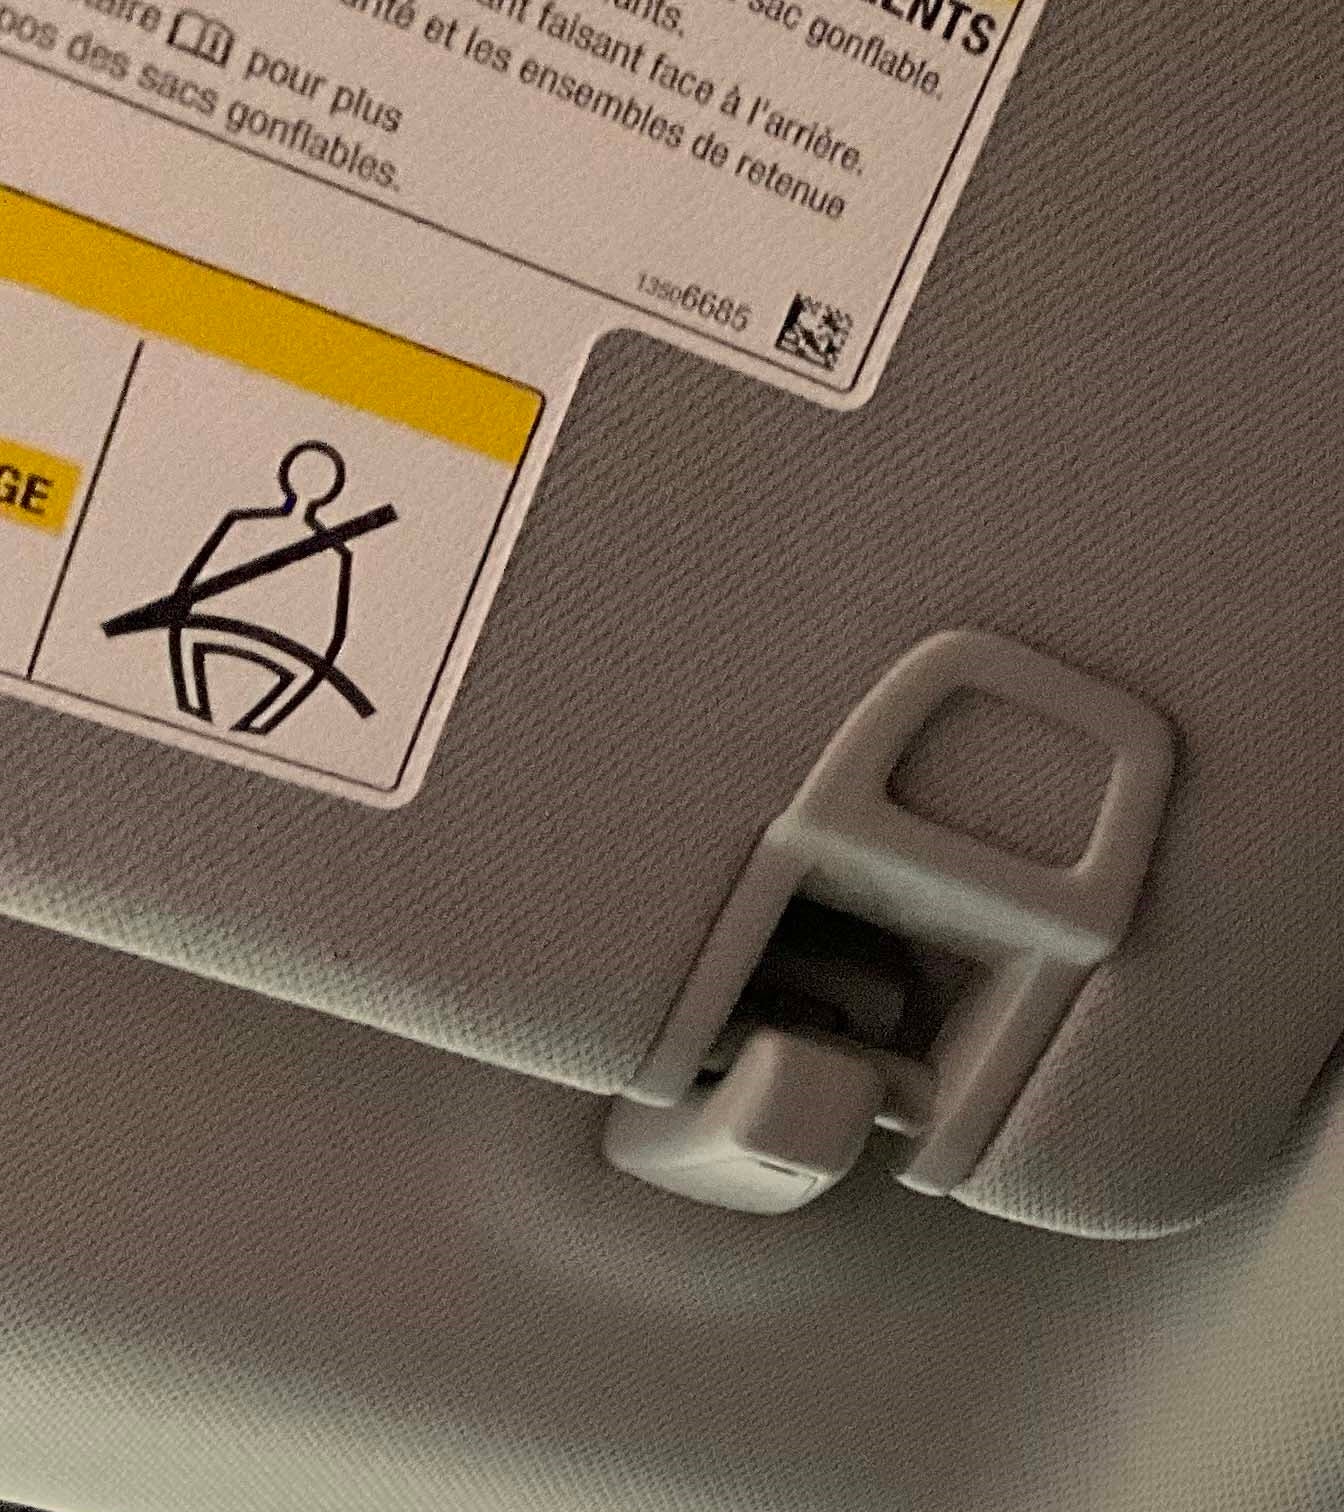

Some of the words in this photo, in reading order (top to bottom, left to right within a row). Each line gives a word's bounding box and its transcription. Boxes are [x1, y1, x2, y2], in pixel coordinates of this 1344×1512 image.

[537, 0, 646, 73] faisant
[650, 53, 714, 106] face
[719, 84, 741, 120] à
[746, 96, 864, 177] l'arrière.
[805, 15, 943, 101] gonflable.
[880, 0, 996, 55] NTS
[66, 31, 131, 82] des
[137, 62, 218, 118] sacs
[225, 99, 400, 192] gonflables.
[244, 48, 329, 100] pour
[329, 85, 403, 133] plus
[423, 15, 458, 50] et
[464, 26, 512, 73] les
[519, 57, 685, 148] ensembles
[691, 131, 729, 169] de
[734, 151, 846, 219] retenue
